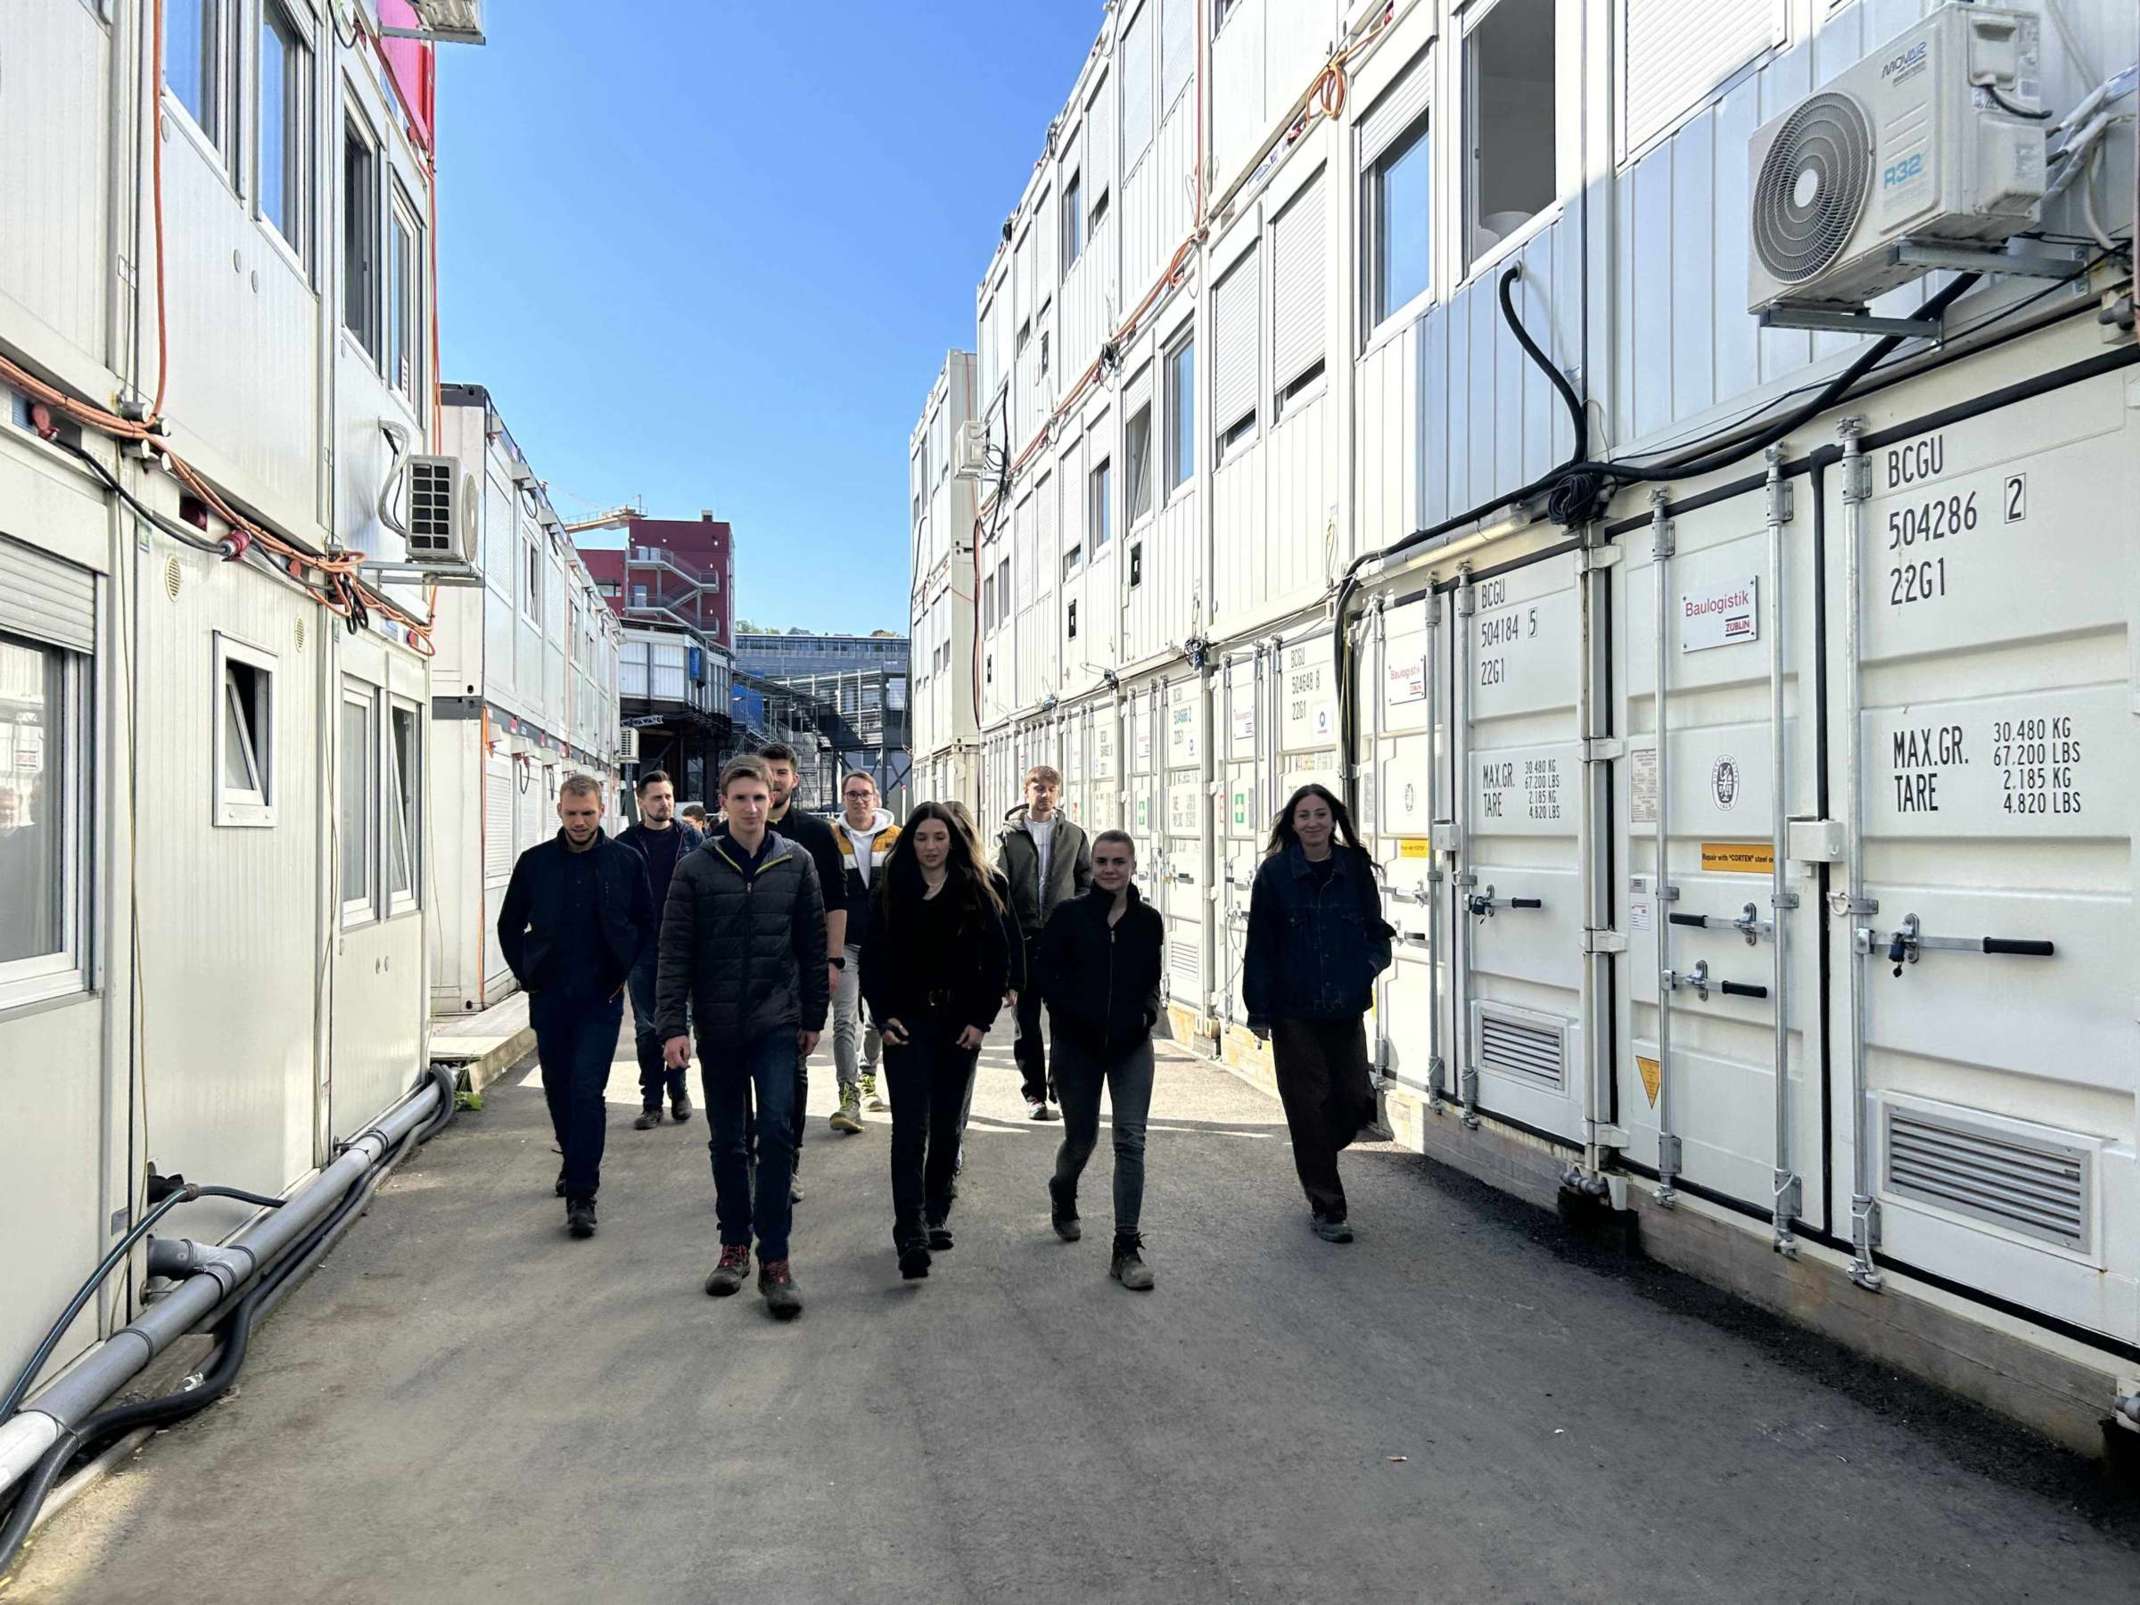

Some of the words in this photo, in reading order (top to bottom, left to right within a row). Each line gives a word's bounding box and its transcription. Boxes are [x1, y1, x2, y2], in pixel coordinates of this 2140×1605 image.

[1888, 434, 1944, 489] BCGU
[1889, 490, 1977, 550] 504286
[2007, 477, 2023, 520] 2
[1481, 578, 1505, 609] BCGU
[1890, 556, 1945, 606] 22G1
[1685, 590, 1749, 617] Baulogistik
[1481, 614, 1519, 648] 504184
[1529, 609, 1537, 636] 5
[1481, 657, 1505, 686] 22G1
[1993, 718, 2046, 743] 30.480
[2052, 716, 2072, 739] KG
[1893, 725, 1969, 769] MAX.GR.
[1993, 743, 2046, 767] 67.200
[2052, 741, 2081, 764] LBS
[1548, 774, 1560, 788] LBS
[1894, 772, 1939, 812] TARE
[2003, 767, 2046, 790] 2.185
[2052, 766, 2072, 789] KG
[1483, 792, 1503, 817] TARE
[1548, 805, 1560, 819] LBS
[2003, 792, 2047, 814] 4.820
[2053, 791, 2082, 814] LBS
